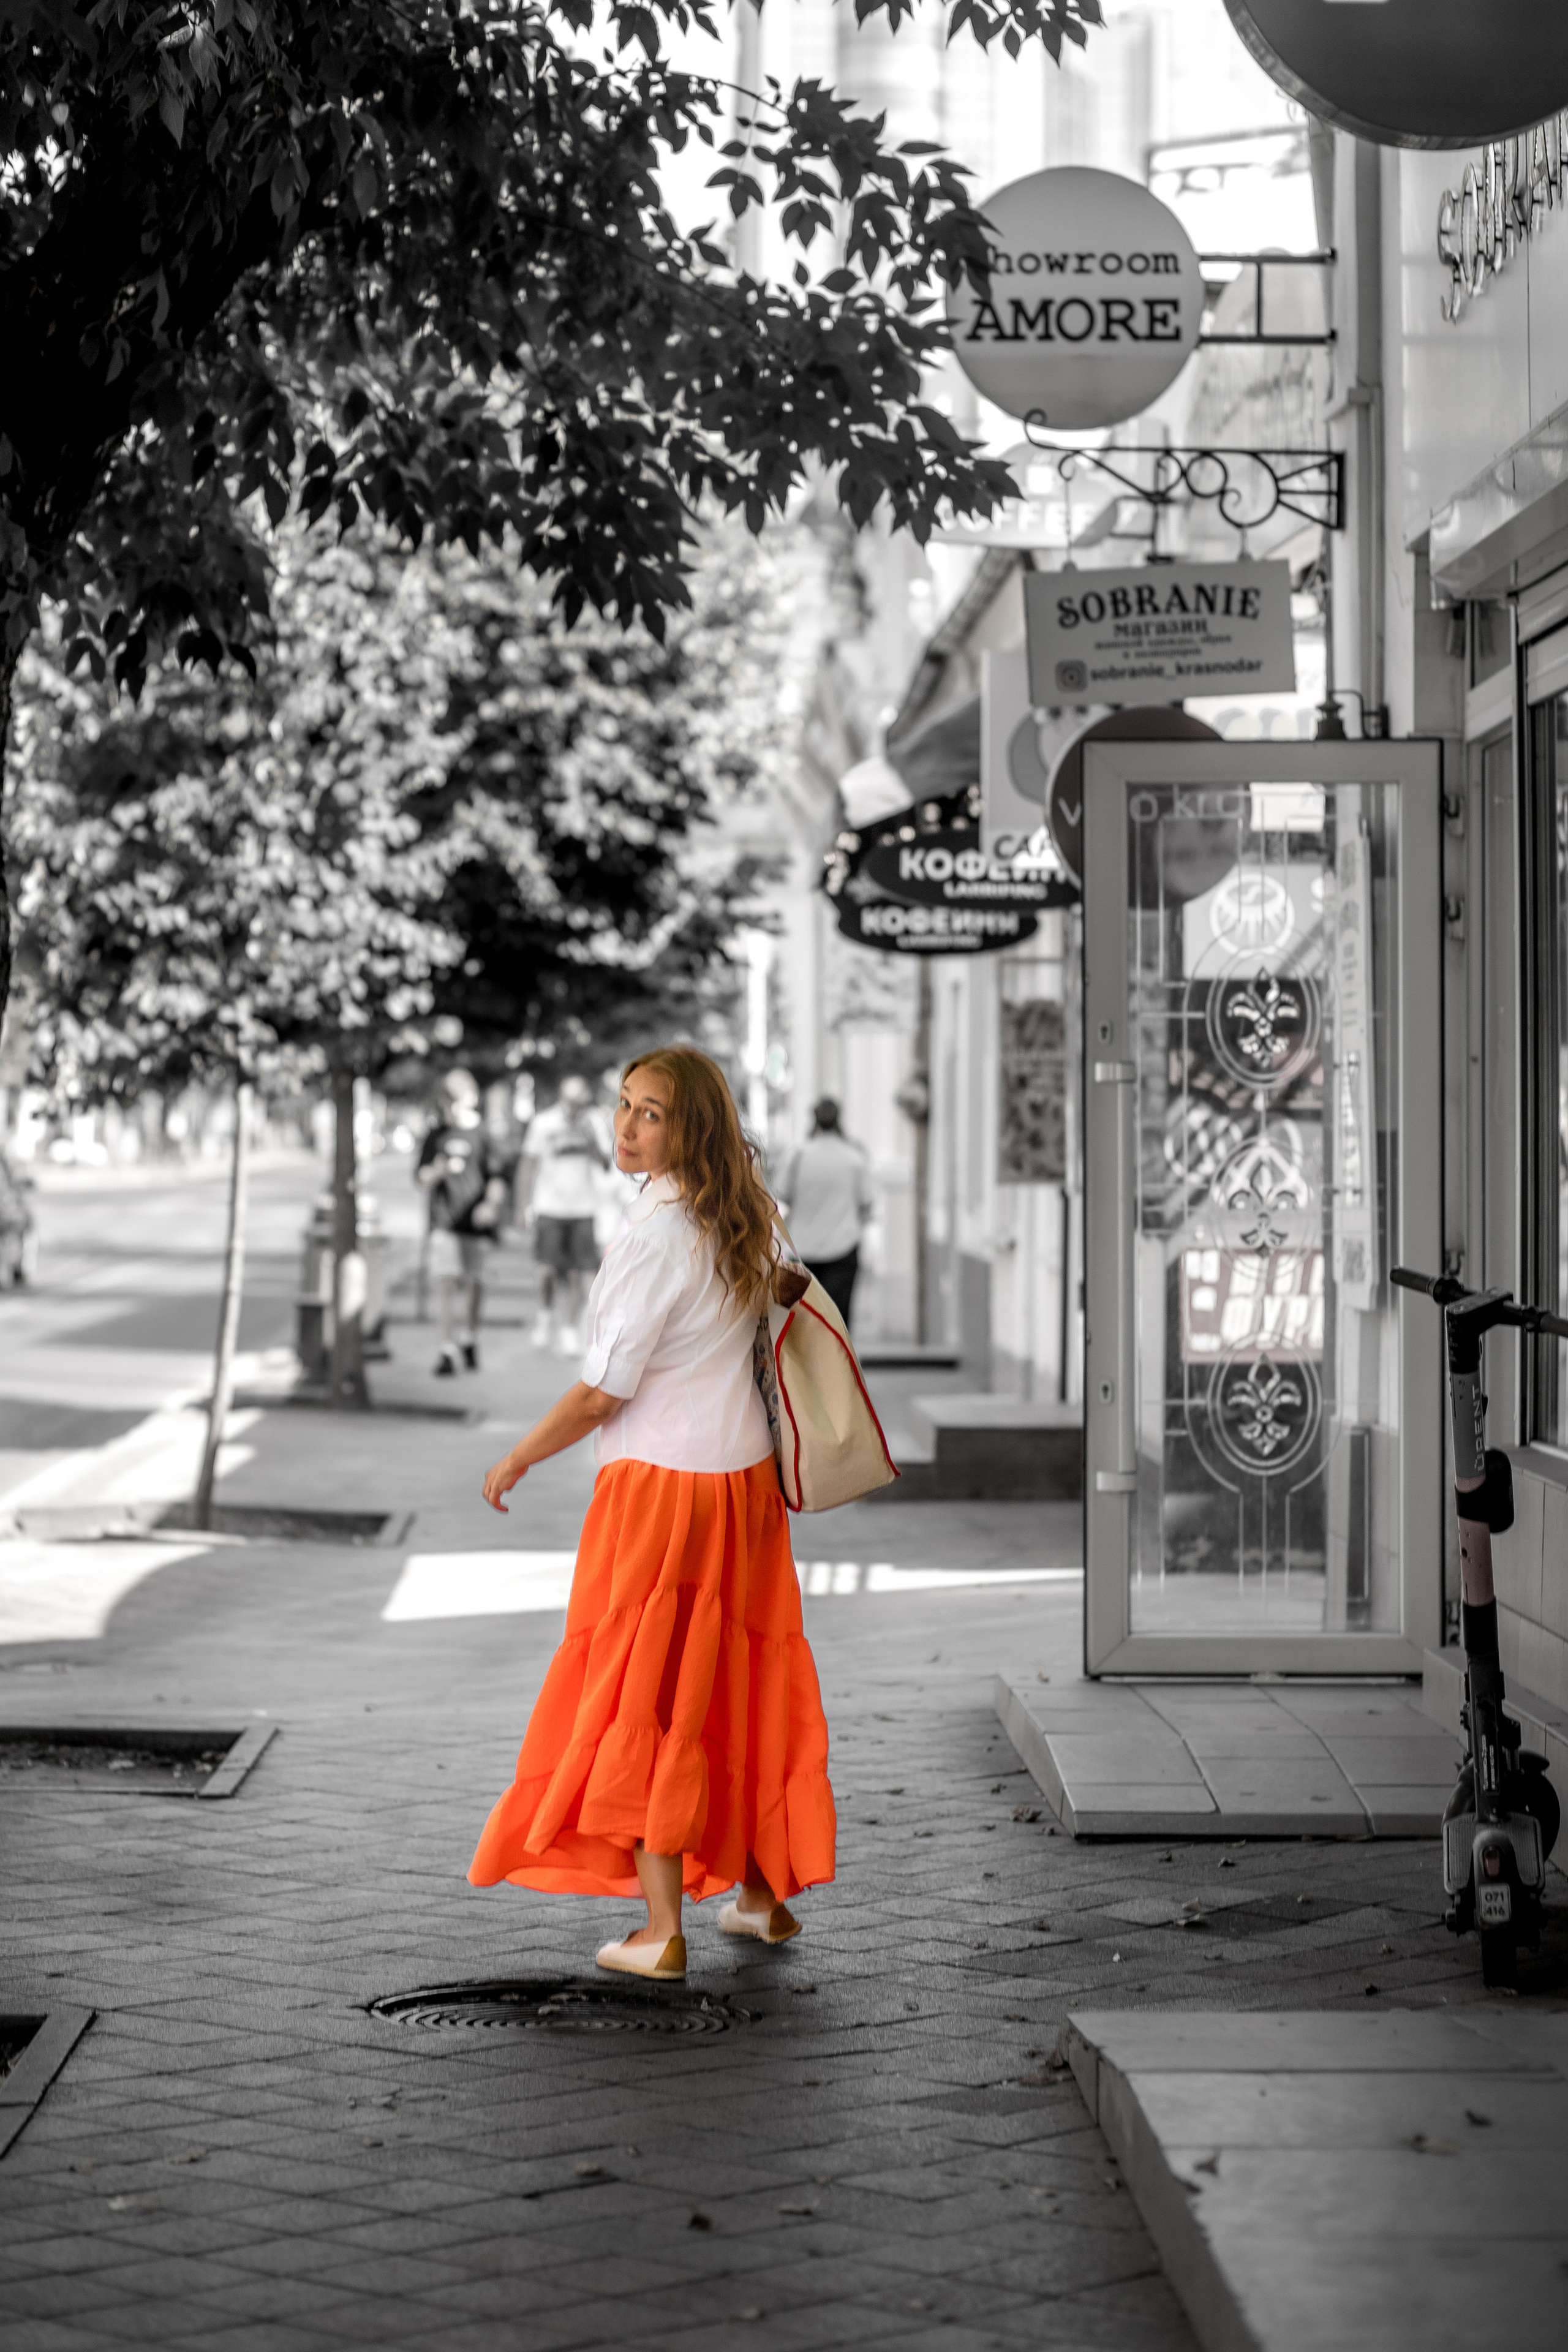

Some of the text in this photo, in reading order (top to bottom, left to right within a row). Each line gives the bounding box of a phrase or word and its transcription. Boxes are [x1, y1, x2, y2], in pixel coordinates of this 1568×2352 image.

[987, 244, 1181, 275] howroom
[965, 297, 1181, 341] AMORE
[1055, 582, 1262, 630] SOBRANIE
